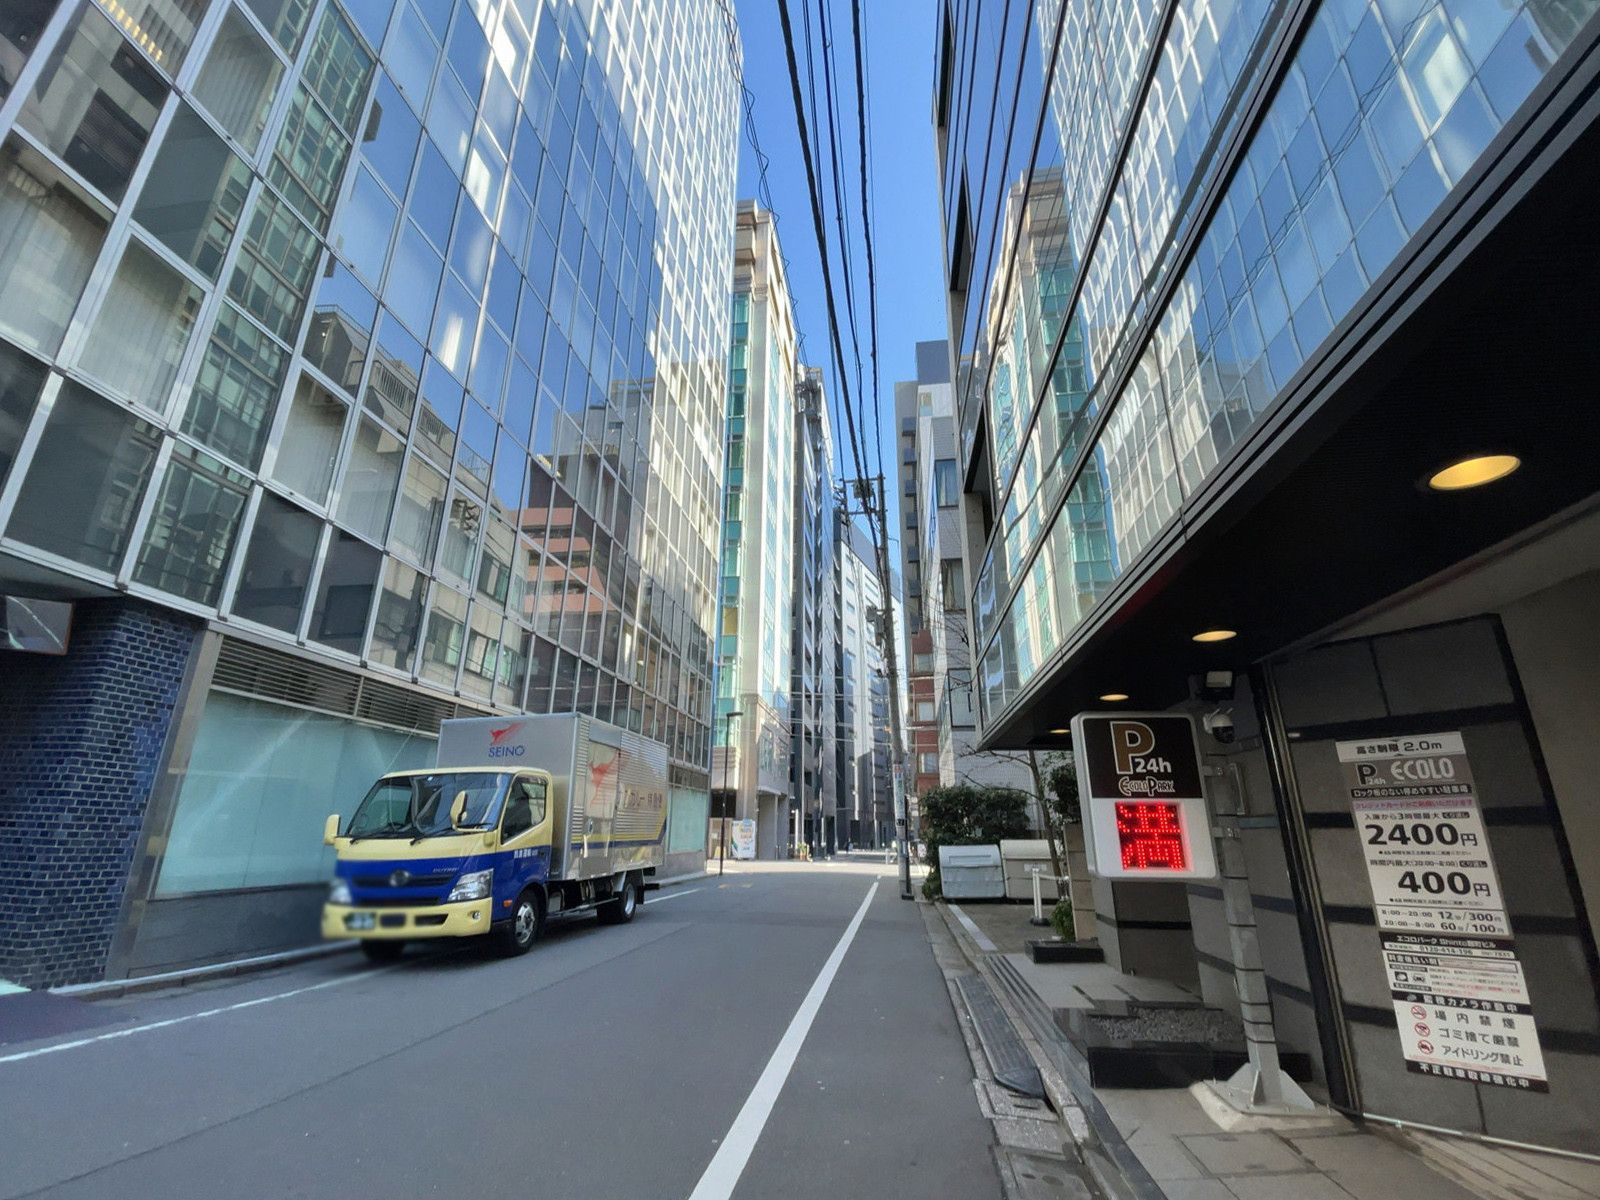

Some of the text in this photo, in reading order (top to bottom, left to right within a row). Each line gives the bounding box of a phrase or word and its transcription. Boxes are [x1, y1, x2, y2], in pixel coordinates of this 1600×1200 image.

[489, 745, 525, 757] SEINO
[1110, 721, 1155, 774] P
[1356, 740, 1443, 755] 高さ制限 2.0m
[1134, 757, 1172, 773] 24h
[1390, 757, 1455, 780] ECOLO
[1115, 801, 1185, 870] 満
[1365, 823, 1478, 846] 2400円
[1398, 871, 1491, 897] 400円
[1441, 1045, 1524, 1067] アイドリング禁止
